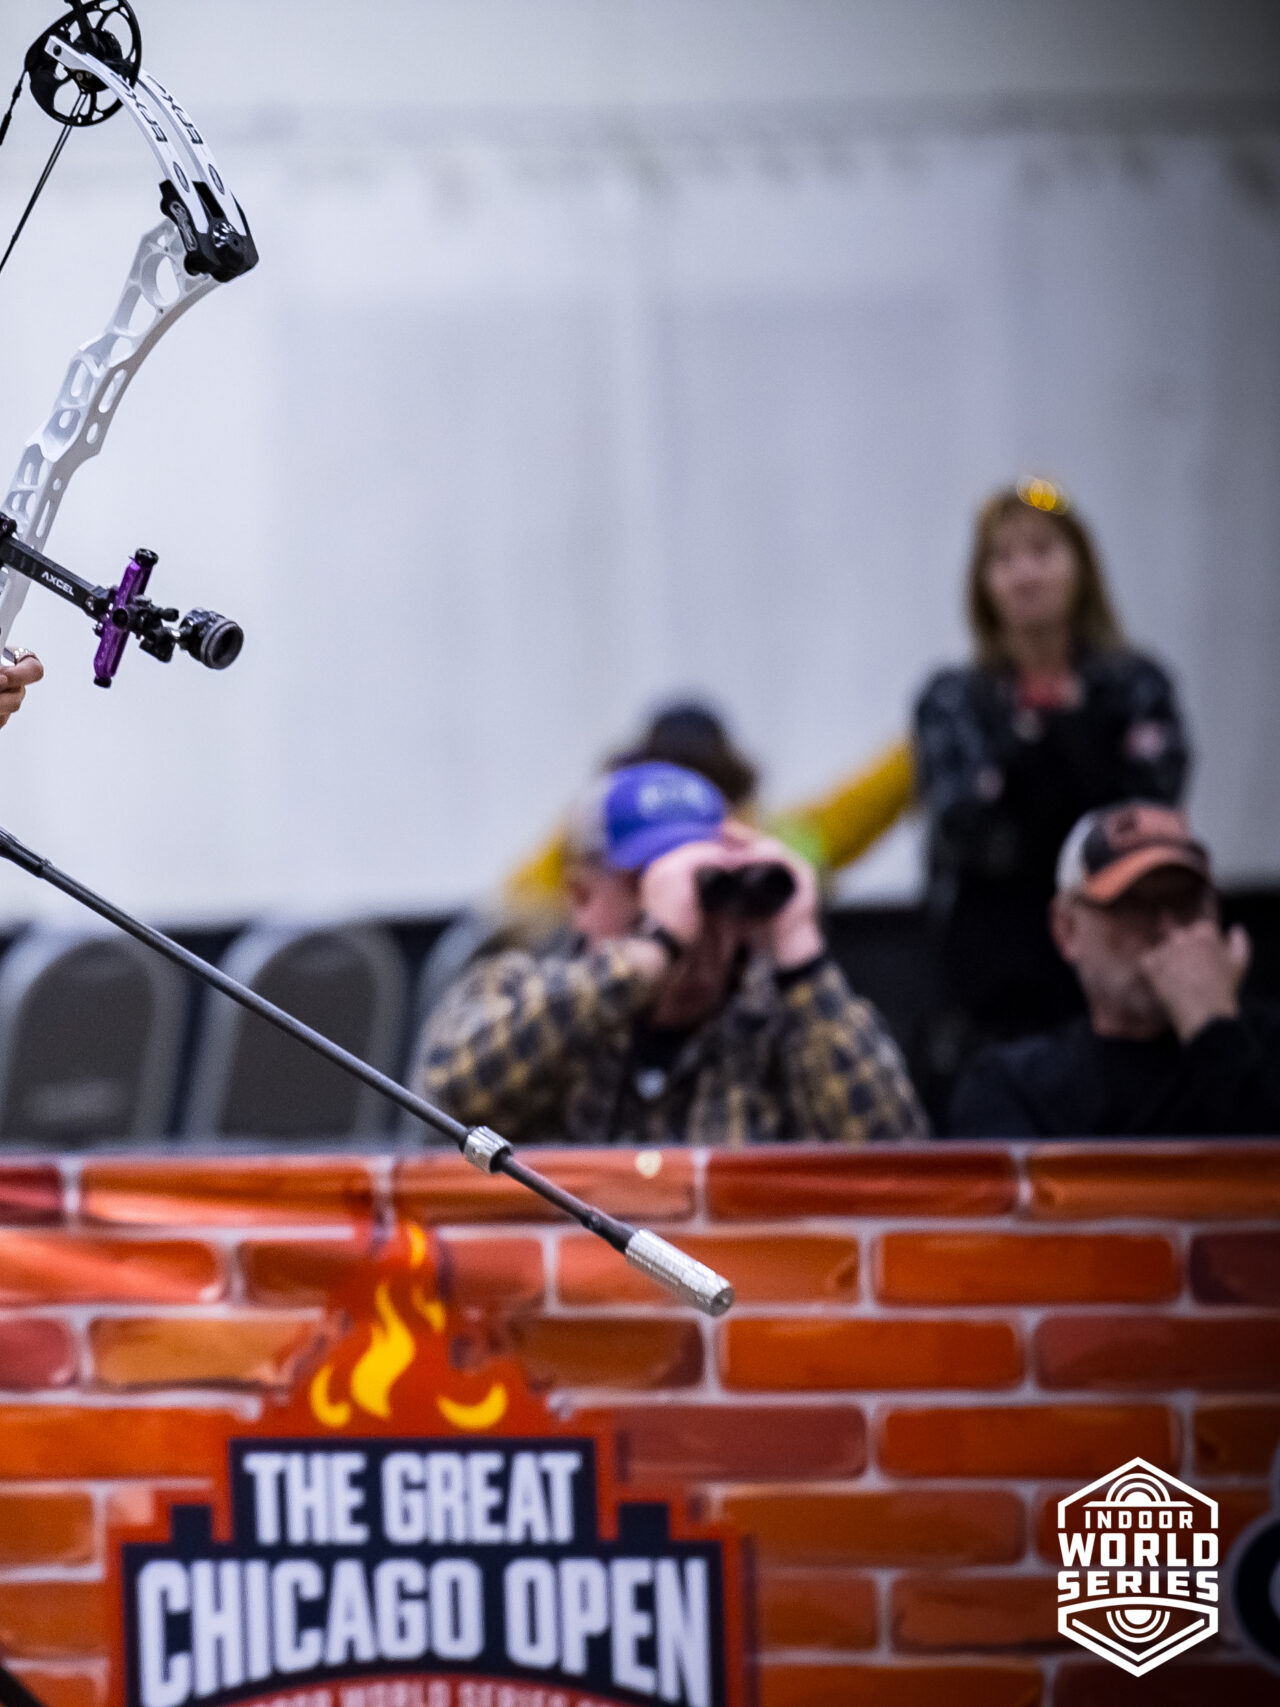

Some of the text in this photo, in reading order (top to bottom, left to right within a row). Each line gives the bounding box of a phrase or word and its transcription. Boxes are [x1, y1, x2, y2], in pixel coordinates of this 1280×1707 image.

[40, 570, 75, 597] AXCEL
[243, 1452, 582, 1545] THE GREAT
[136, 1557, 711, 1707] CHICAGO OPEN
